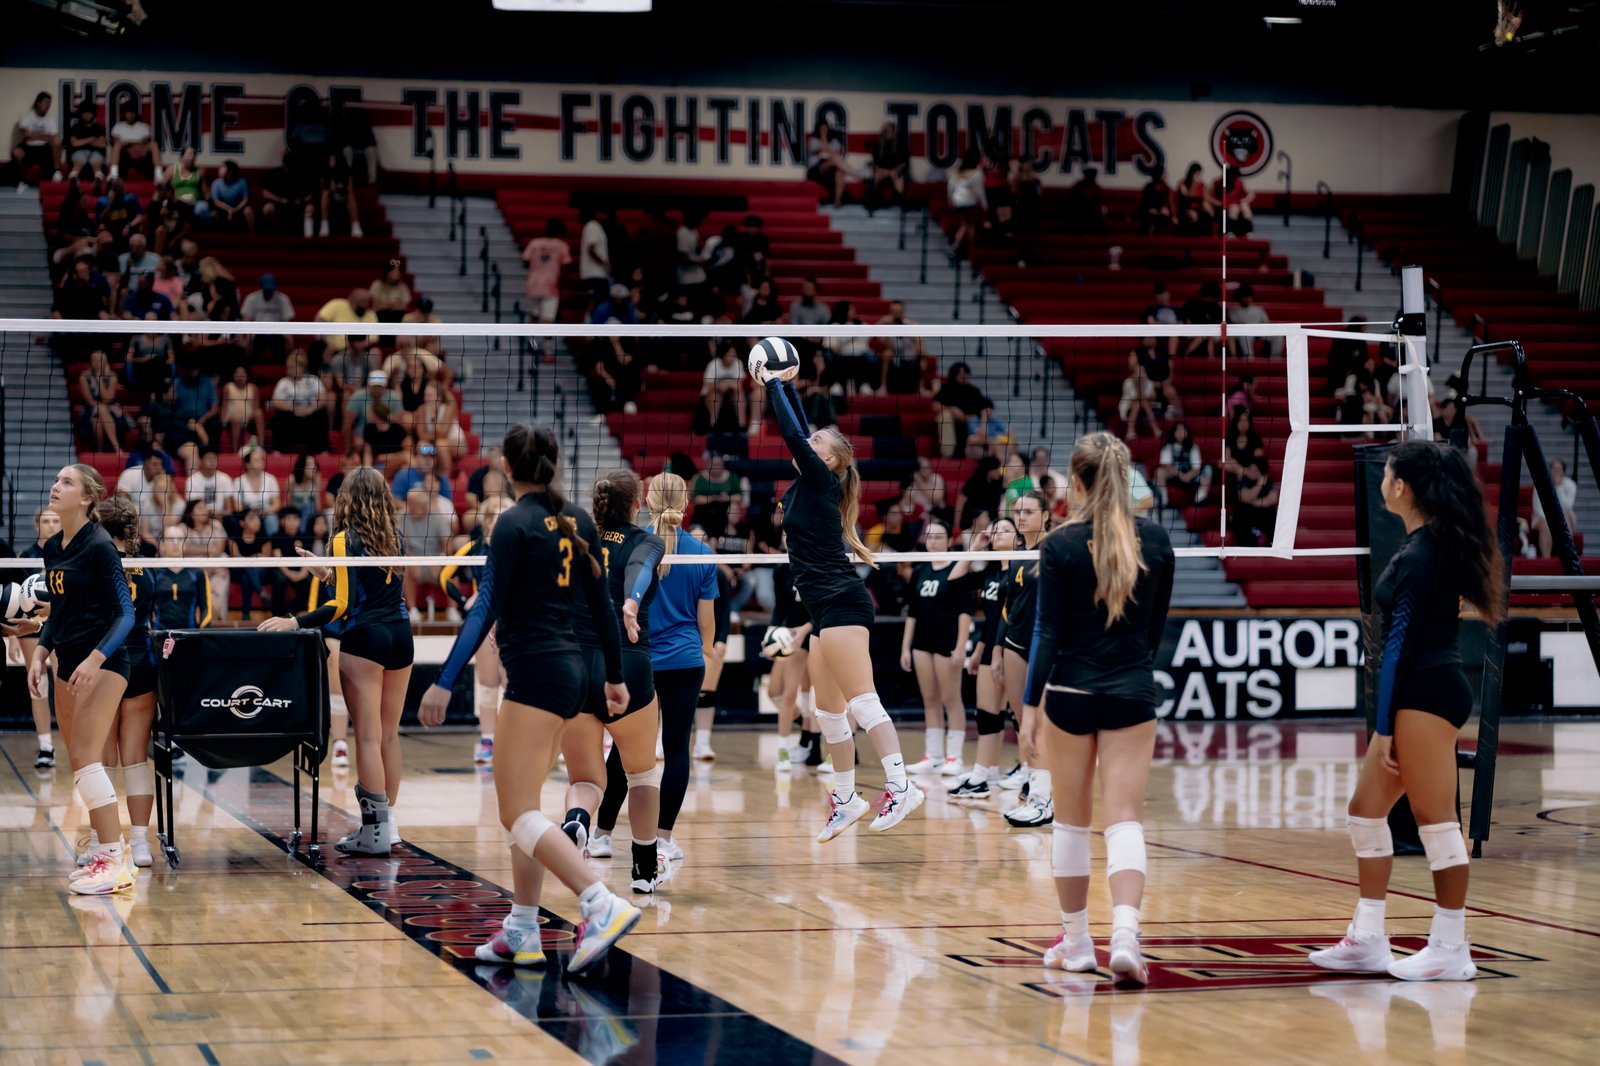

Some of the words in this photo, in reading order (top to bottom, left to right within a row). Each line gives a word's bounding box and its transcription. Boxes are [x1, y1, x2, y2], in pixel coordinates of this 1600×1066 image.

[402, 87, 522, 160] THE
[556, 536, 574, 588] 3
[48, 569, 66, 596] 18
[919, 579, 940, 598] 20
[1015, 565, 1025, 588] 4
[171, 583, 178, 601] 1
[1170, 618, 1365, 669] AUROR
[200, 697, 250, 708] COURT
[252, 697, 293, 709] CART
[1152, 668, 1283, 719] CATS
